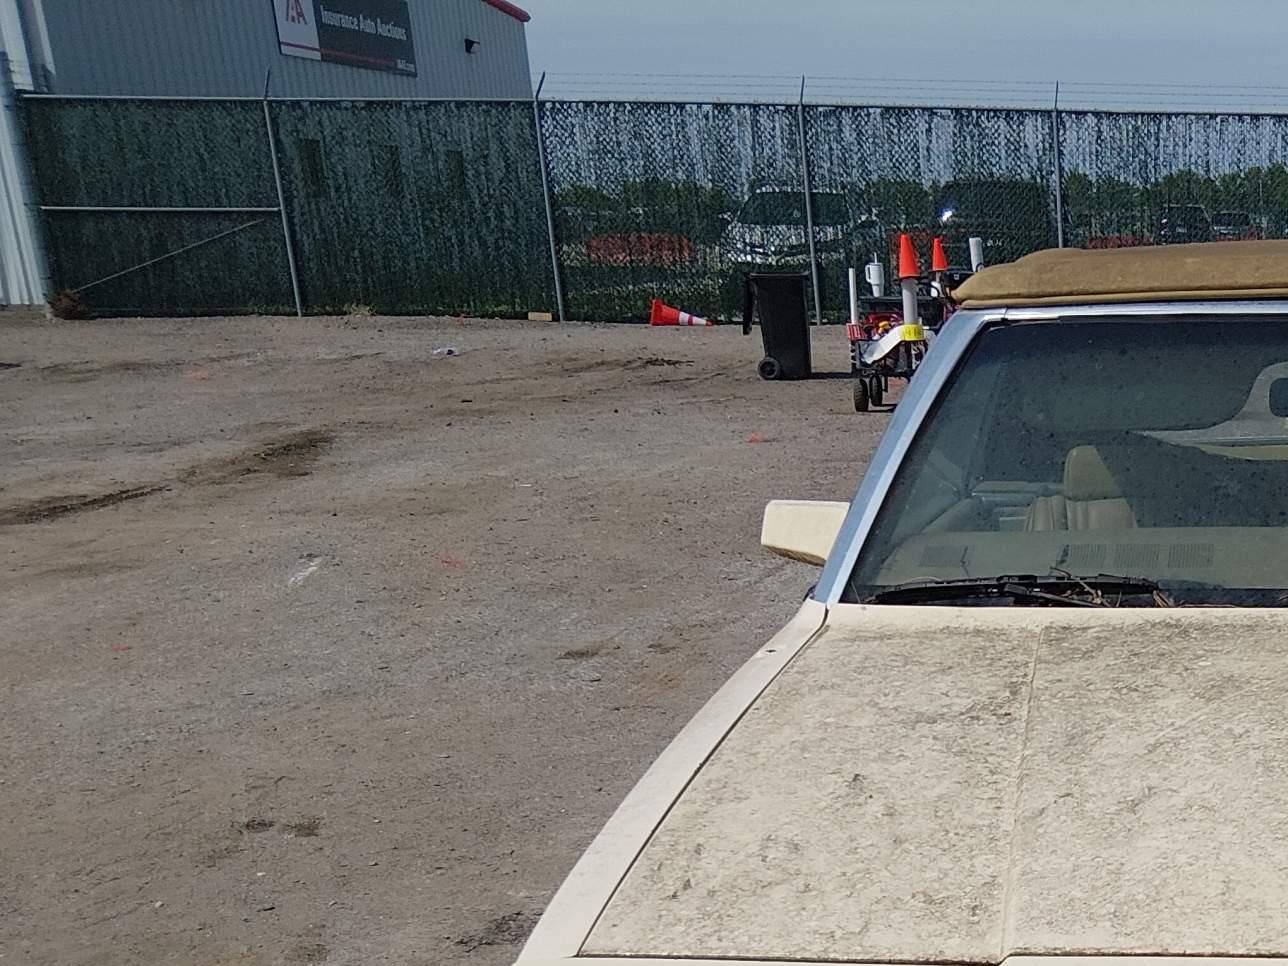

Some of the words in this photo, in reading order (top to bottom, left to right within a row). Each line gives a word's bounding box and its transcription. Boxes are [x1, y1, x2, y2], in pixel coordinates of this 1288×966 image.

[320, 4, 359, 30] Insurance
[359, 14, 377, 35] Auto
[377, 18, 407, 41] Auctions
